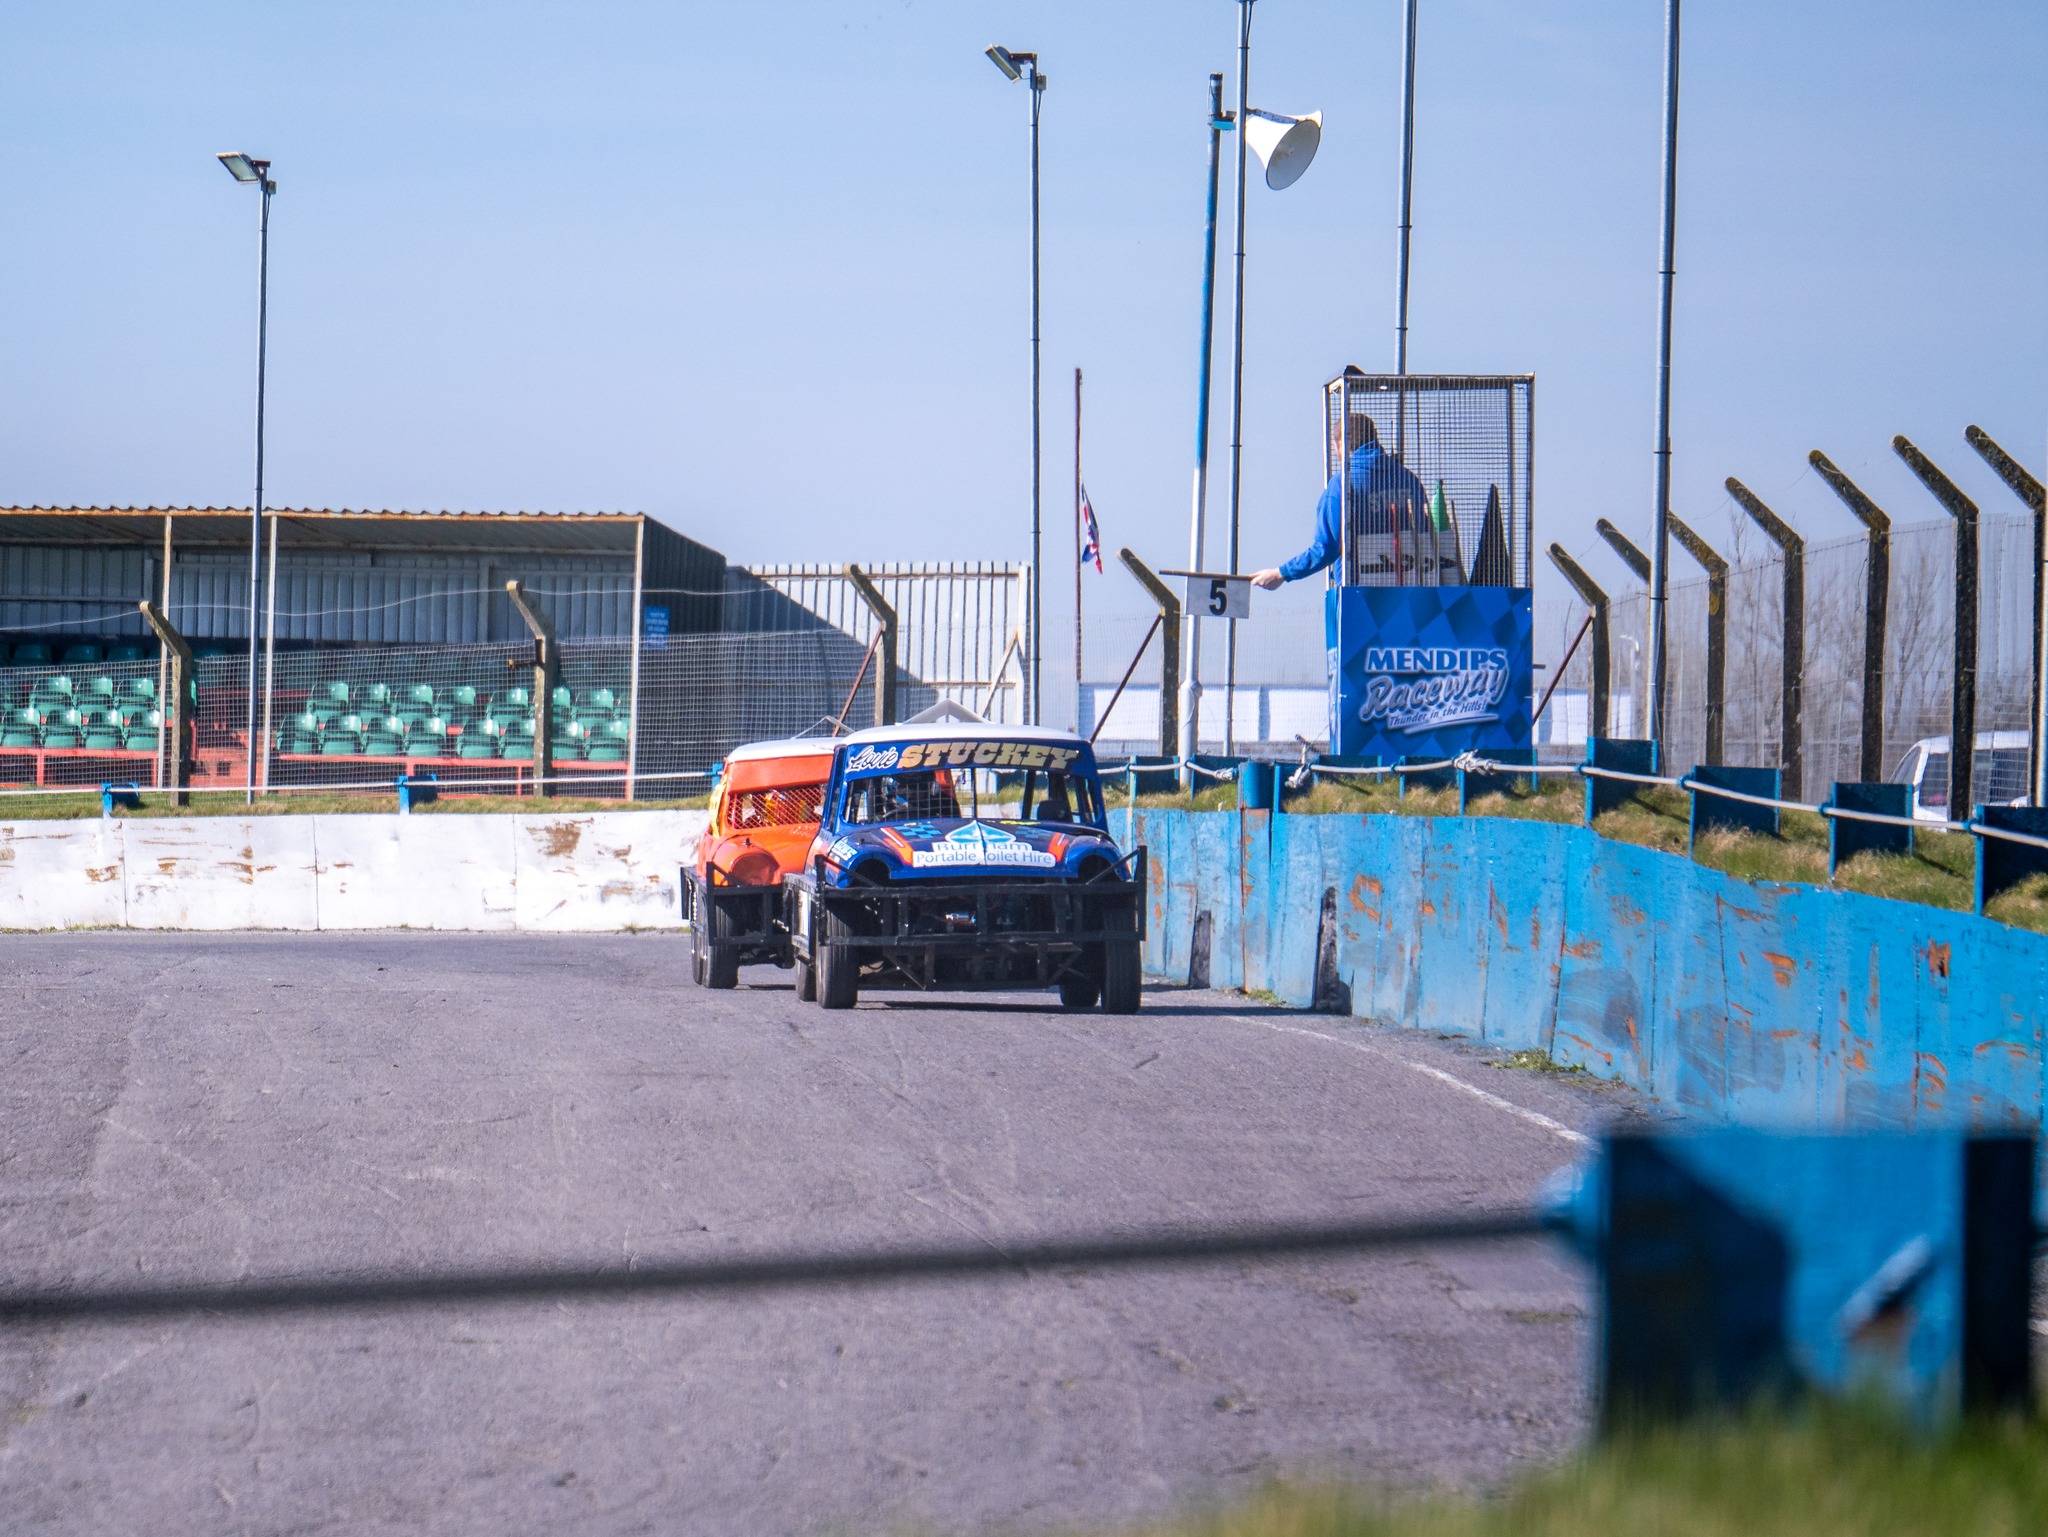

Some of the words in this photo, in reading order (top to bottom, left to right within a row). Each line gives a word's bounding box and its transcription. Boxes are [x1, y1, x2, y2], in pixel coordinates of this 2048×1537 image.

[1209, 579, 1227, 615] 5
[1367, 649, 1507, 671] MENDIPS
[1360, 669, 1508, 720] Raceway
[1389, 713, 1428, 726] Thunder
[1430, 710, 1439, 720] in
[1442, 706, 1458, 719] the
[1460, 700, 1487, 714] Hills!
[898, 742, 1079, 769] STUCKEY
[917, 851, 977, 863] Portable
[985, 851, 1018, 862] oilet
[1022, 853, 1052, 864] Hire
